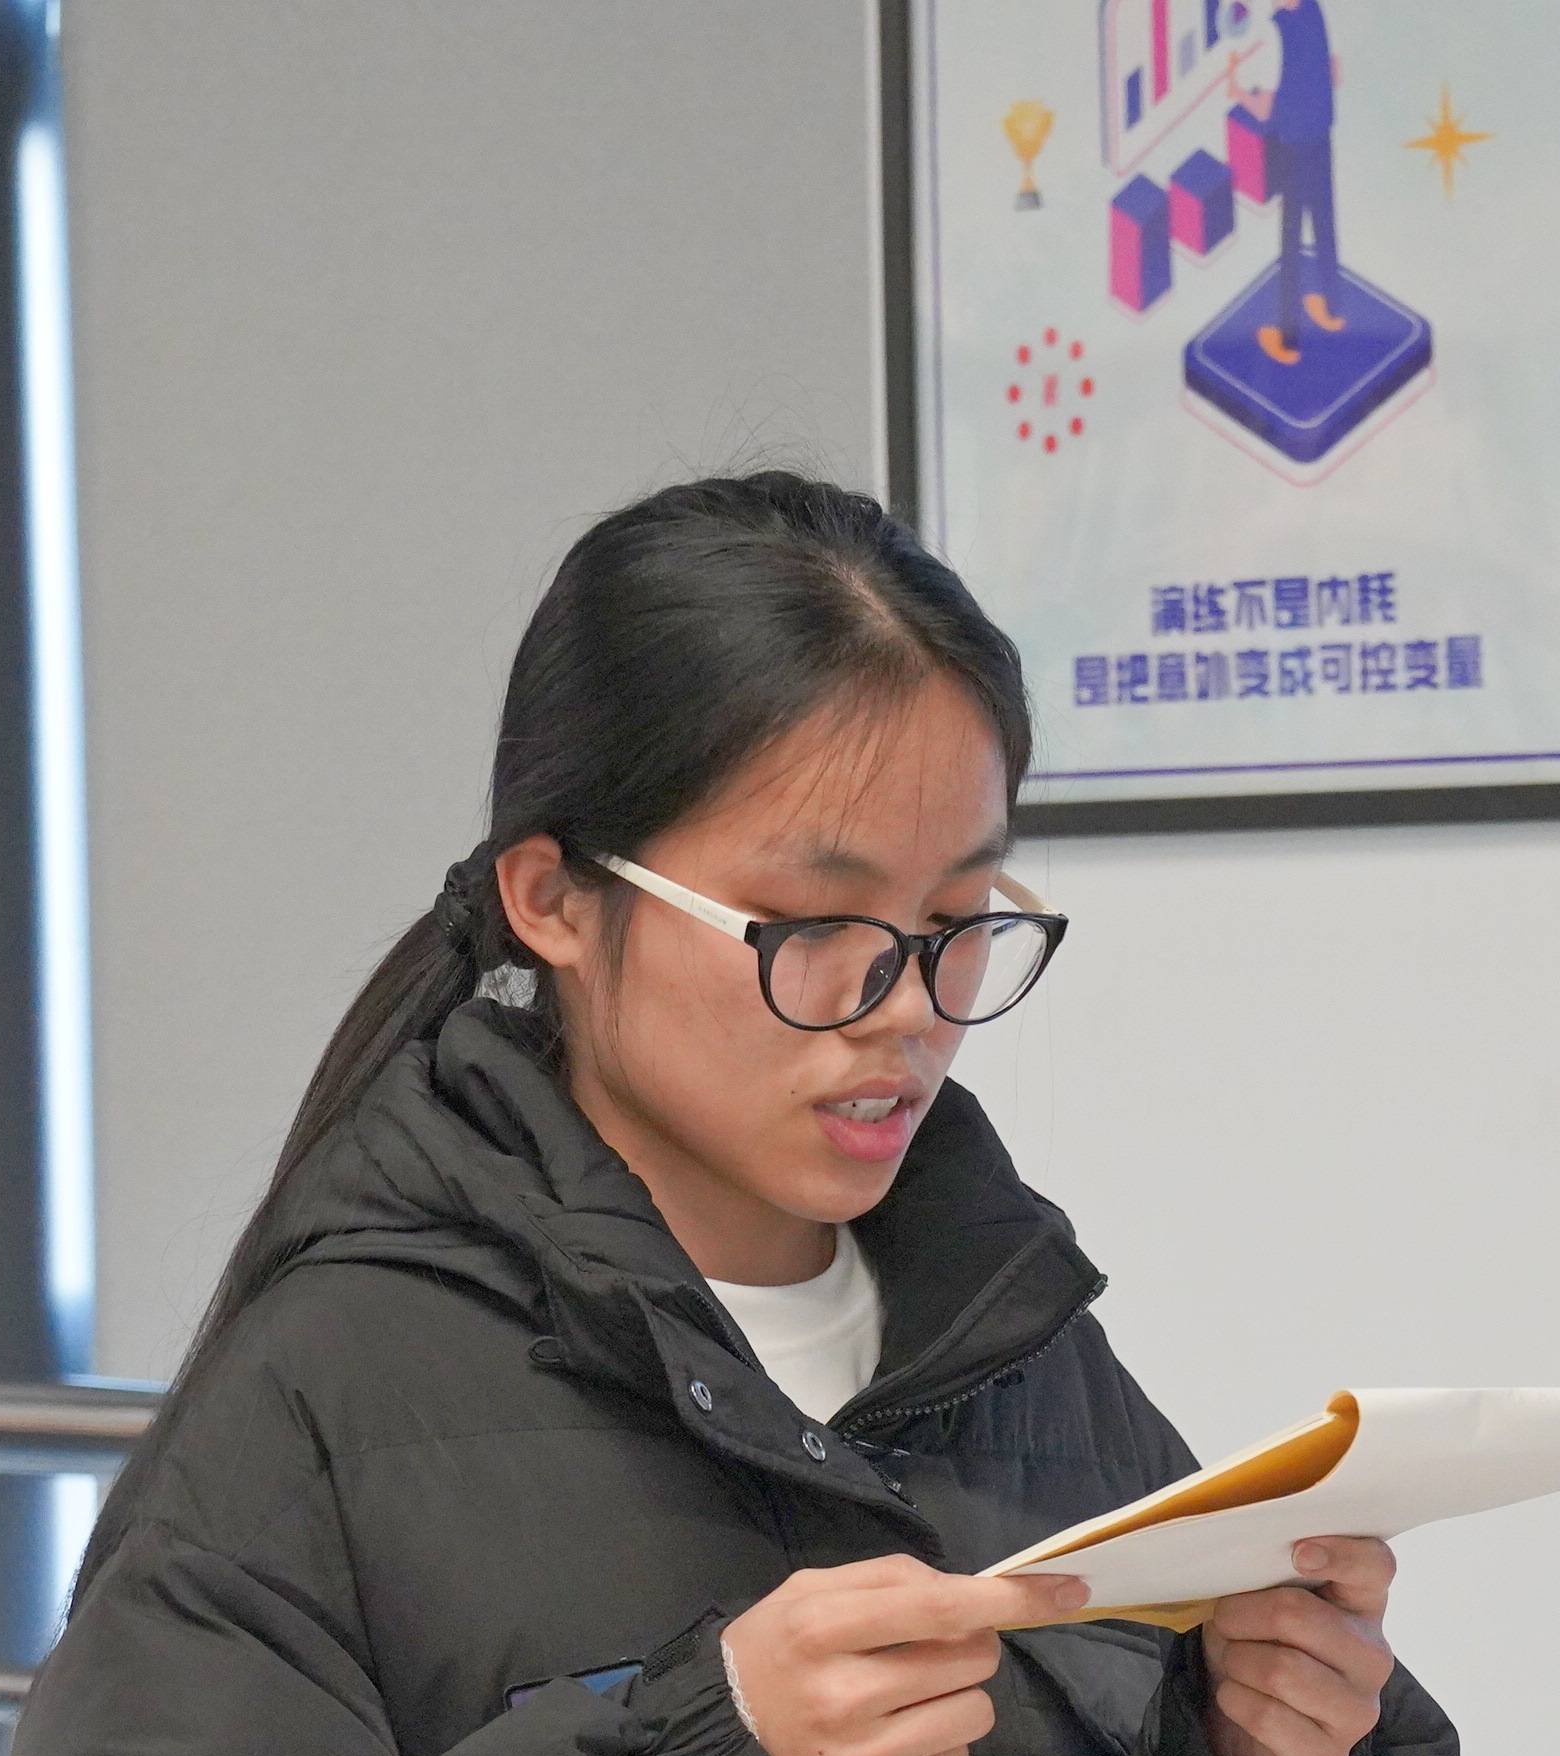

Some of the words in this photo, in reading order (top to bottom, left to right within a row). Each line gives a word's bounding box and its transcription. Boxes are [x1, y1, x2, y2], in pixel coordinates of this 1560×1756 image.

[1151, 570, 1397, 635] 演练不是内耗
[1073, 635, 1482, 707] 是把意外变成可控变量
